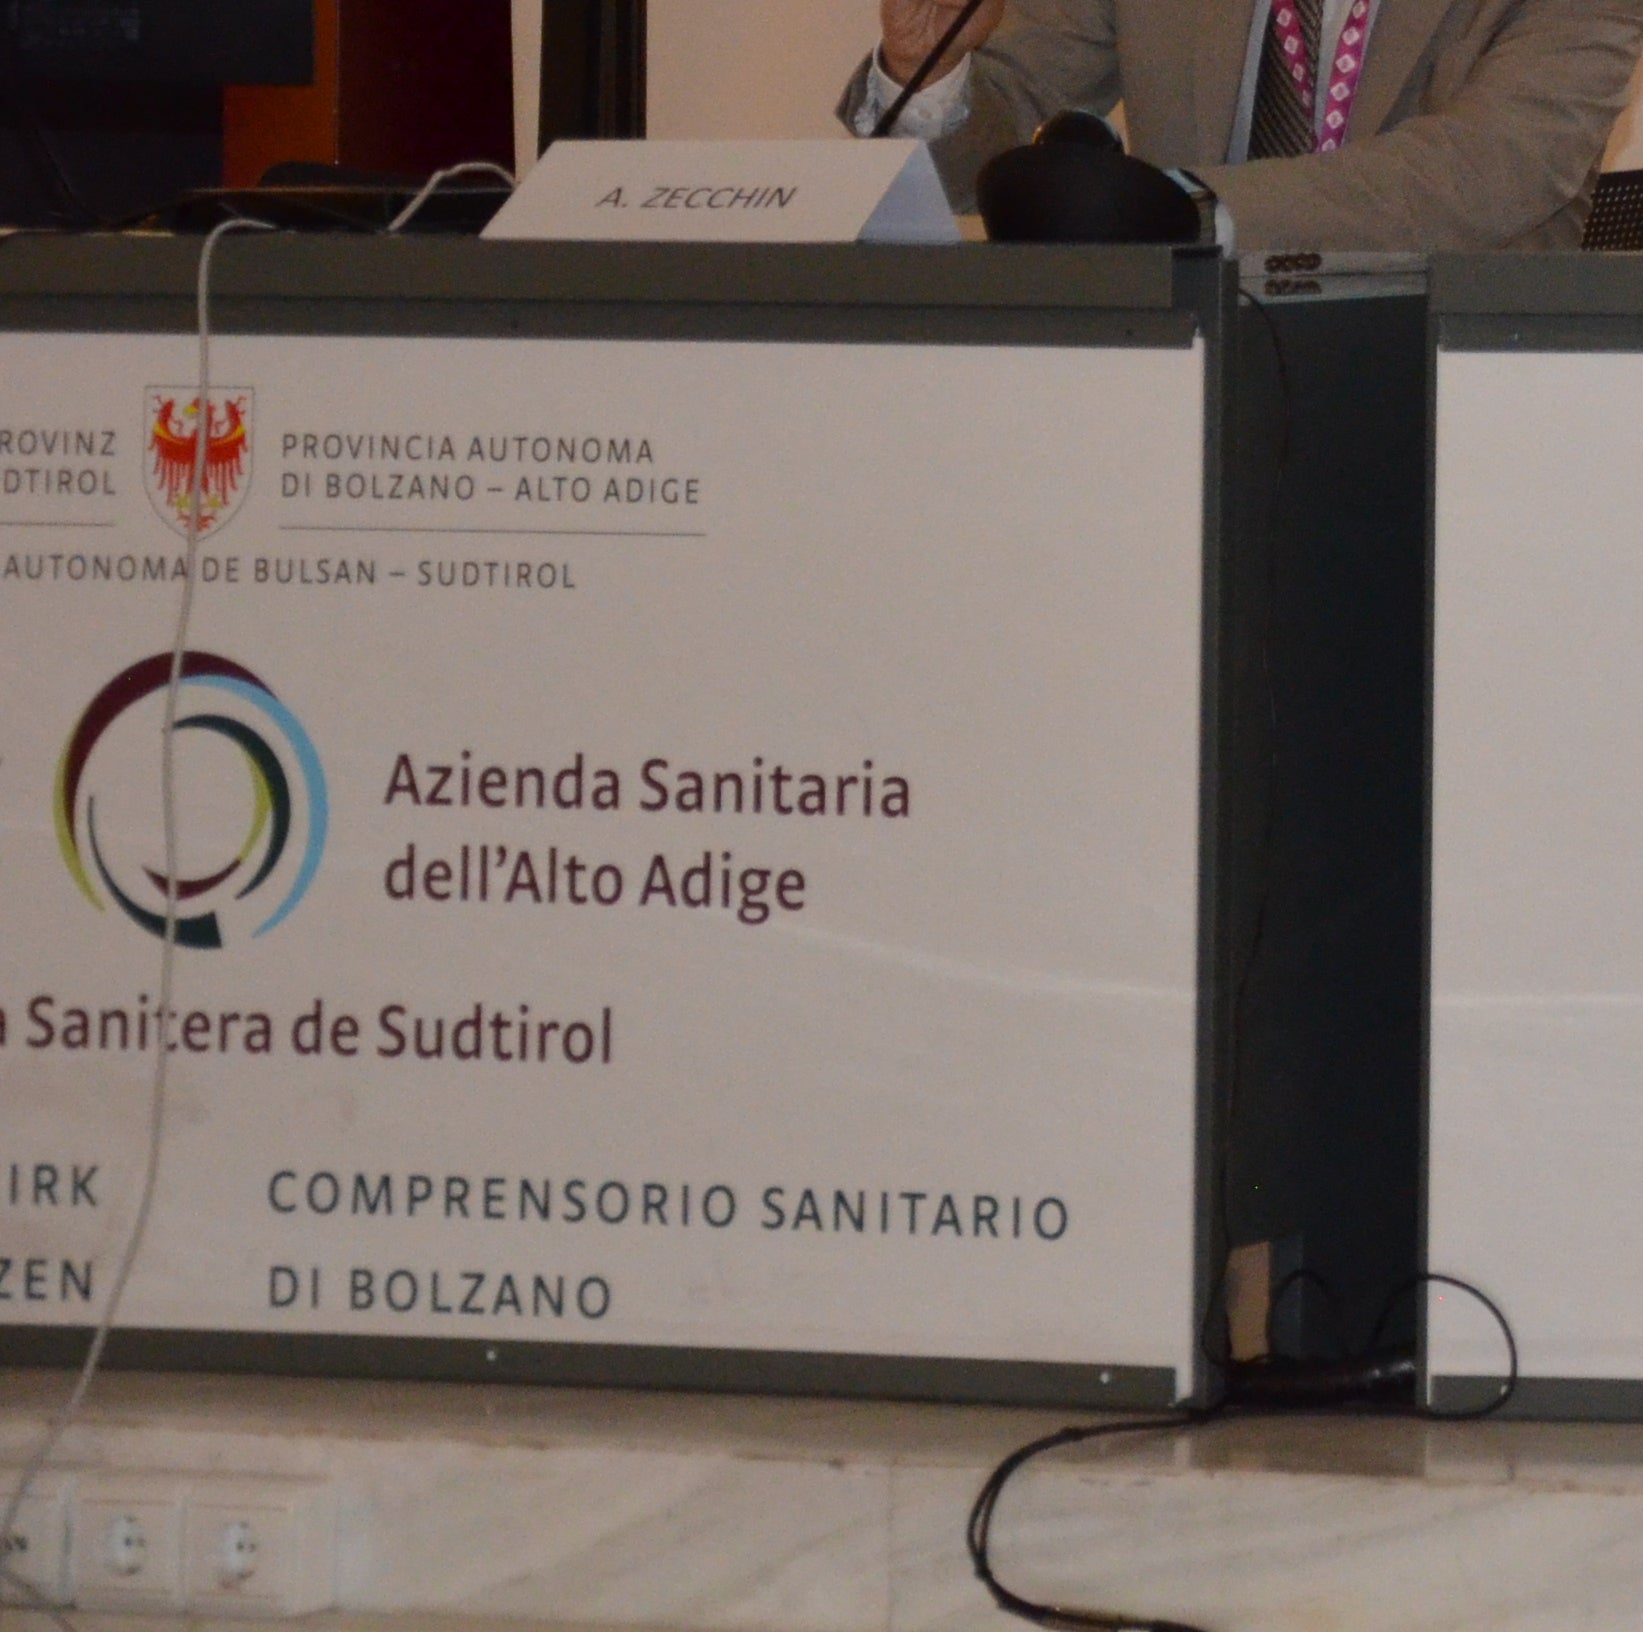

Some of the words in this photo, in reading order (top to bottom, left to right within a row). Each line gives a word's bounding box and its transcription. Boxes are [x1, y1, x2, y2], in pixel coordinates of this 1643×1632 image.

[594, 186, 635, 209] A.
[640, 186, 798, 210] ZECCHIN
[281, 432, 456, 461] PROVINCIA
[467, 435, 654, 464] AUTONOMA
[2, 466, 116, 496] DTIROL
[280, 471, 312, 499] DI
[325, 471, 476, 501] BOLZANO
[514, 475, 592, 504] ALTO
[602, 476, 700, 505] ADIGE
[4, 553, 188, 583] AUTONOMA
[201, 555, 239, 583] DE
[254, 557, 376, 585] BULSAN
[417, 559, 576, 590] SUDTIROL
[384, 749, 621, 811] Azienda
[639, 756, 910, 818] Sanitaria
[639, 850, 806, 926] Adige
[291, 998, 360, 1057] de
[376, 1002, 612, 1064] Sudtirol
[9, 1163, 99, 1208] IRK
[267, 1169, 737, 1229] COMPRENSORIO
[761, 1186, 1069, 1241] SANITARIO
[268, 1265, 320, 1309] DI
[349, 1267, 611, 1320] BOLZANO
